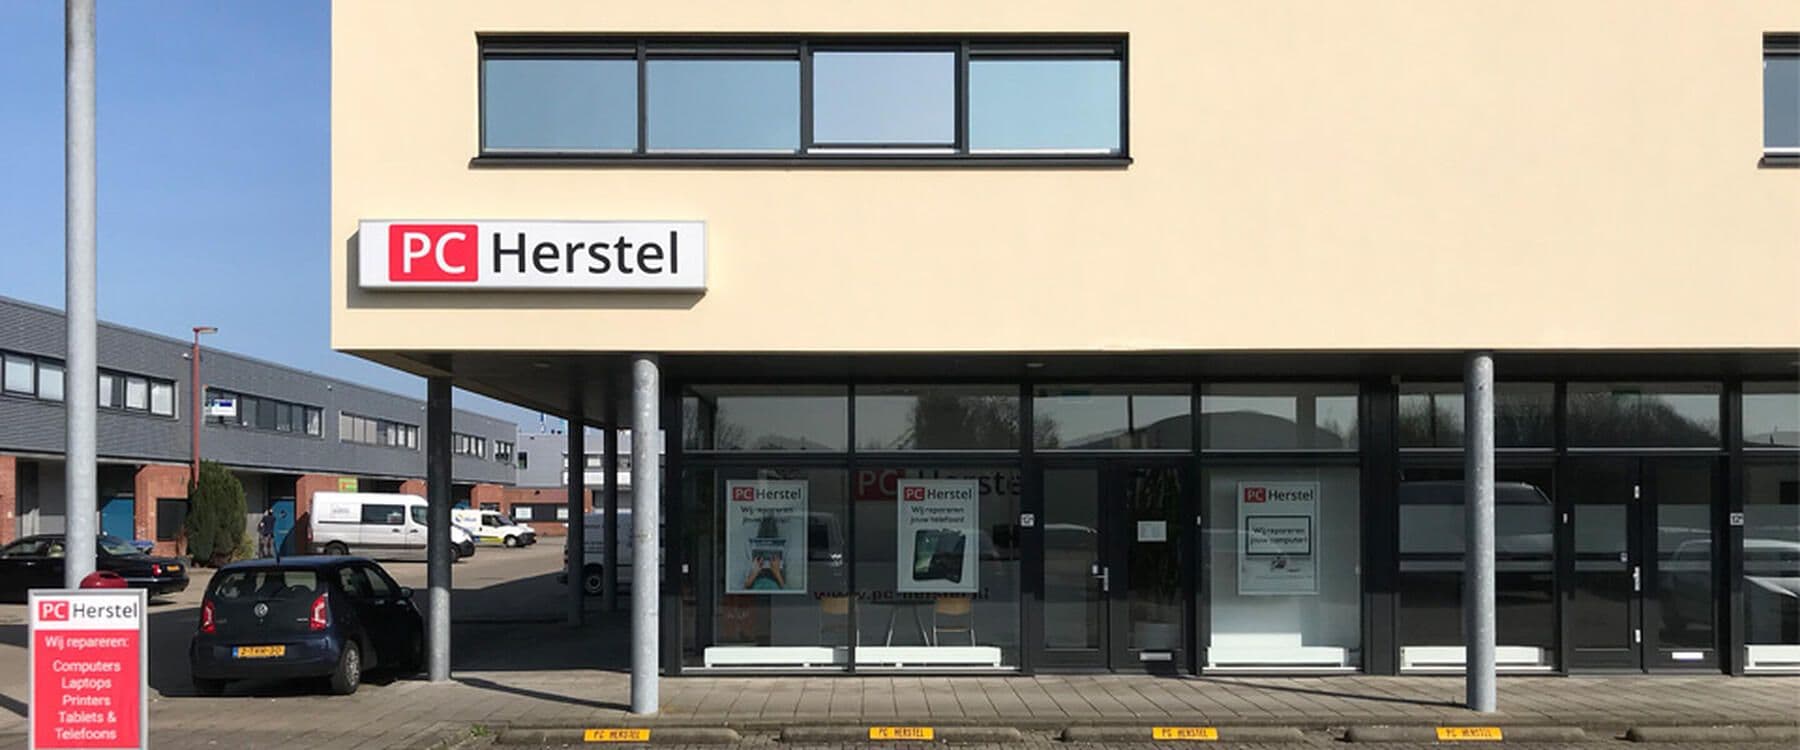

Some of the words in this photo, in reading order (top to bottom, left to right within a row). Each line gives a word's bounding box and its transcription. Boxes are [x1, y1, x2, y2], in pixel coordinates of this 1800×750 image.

[403, 232, 467, 274] PC
[493, 231, 678, 274] Herstel
[735, 488, 753, 500] PC
[756, 488, 802, 500] Herstel
[905, 488, 923, 500] PC
[927, 488, 972, 500] Herstel
[1247, 489, 1264, 501] PC
[1268, 489, 1313, 501] Herstel
[42, 602, 65, 619] PC
[72, 602, 138, 618] Herstel
[45, 636, 64, 650] Wij
[66, 637, 130, 650] repareren:
[52, 660, 121, 674] Computers
[61, 677, 112, 691] Laptops
[62, 695, 111, 707] Printers
[58, 711, 104, 723] Tablets
[107, 711, 117, 723] &
[55, 728, 117, 740] Telefoons
